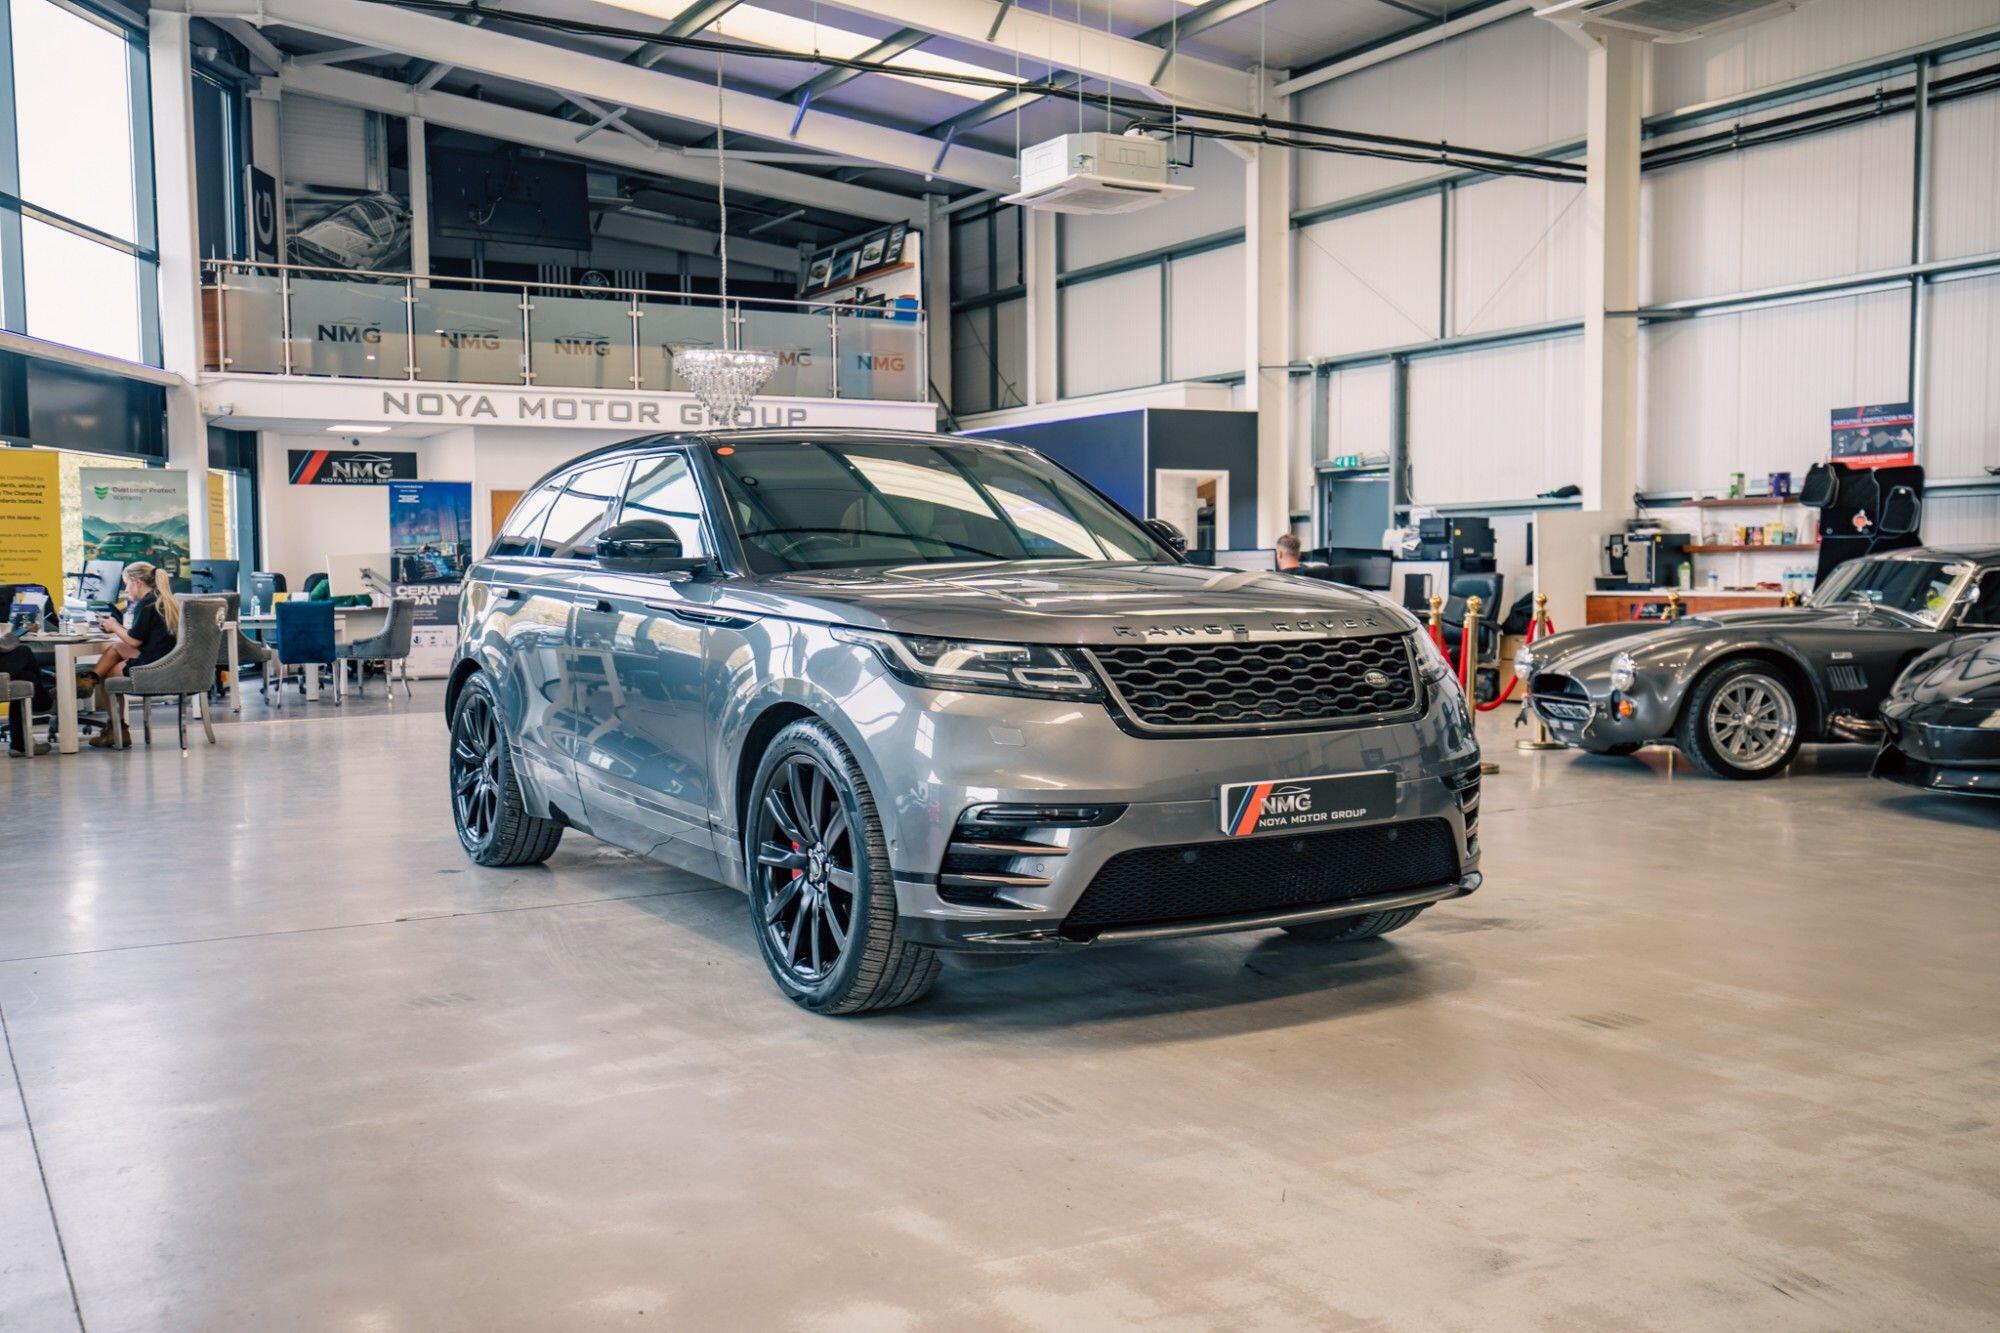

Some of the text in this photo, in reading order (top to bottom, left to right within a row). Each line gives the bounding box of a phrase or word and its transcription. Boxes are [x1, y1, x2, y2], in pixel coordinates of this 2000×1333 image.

[317, 324, 382, 344] NMG
[440, 332, 500, 350] NMG
[554, 338, 610, 356] NMG
[777, 351, 813, 367] MG
[857, 354, 905, 372] NMG
[383, 391, 498, 418] NOYA
[518, 396, 661, 424] MOTOR
[331, 461, 393, 478] NMG
[111, 486, 177, 495] Customer Protect
[1112, 616, 1379, 637] RANGE ROVER
[1260, 793, 1312, 815] NMG
[1258, 808, 1367, 828] NOYA MOTOR GROUP
